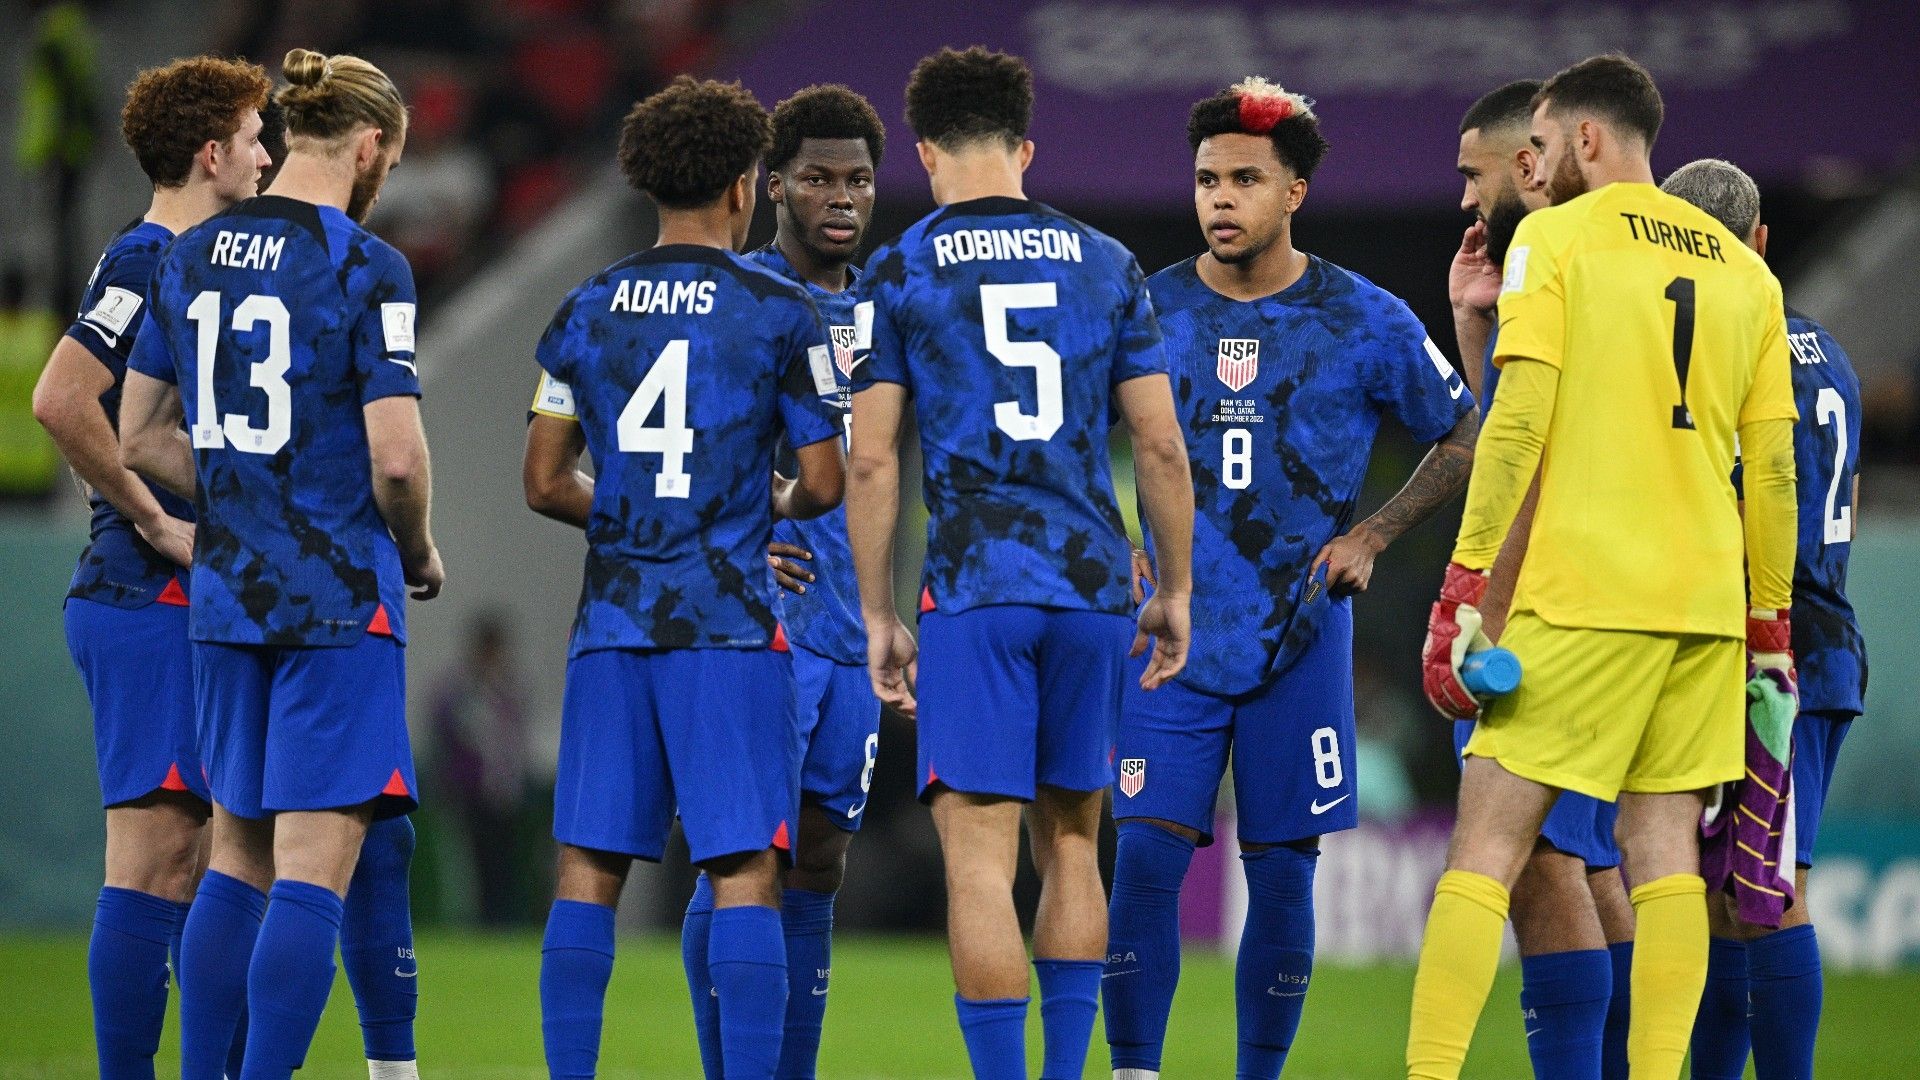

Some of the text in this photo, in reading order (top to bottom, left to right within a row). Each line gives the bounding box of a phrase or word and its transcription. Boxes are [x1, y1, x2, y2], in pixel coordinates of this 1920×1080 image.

[211, 231, 286, 271] REAM
[934, 229, 1083, 266] ROBINSON
[1620, 212, 1726, 263] TURNER
[610, 280, 717, 315] ADAMS
[832, 328, 857, 349] USA
[1221, 341, 1257, 361] USA
[1664, 276, 1697, 431] 1
[1787, 332, 1828, 365] DEST
[186, 290, 291, 454] 13
[979, 282, 1064, 442] 5
[616, 339, 694, 499] 4
[1211, 414, 1264, 423] 29 NOVEMBER 2022
[1220, 399, 1234, 407] IRAN
[1244, 399, 1256, 407] USA
[1220, 407, 1256, 415] DOHA, QATAR
[1222, 428, 1252, 490] 8
[1815, 387, 1852, 545] 2
[1122, 760, 1144, 776] USA
[1310, 726, 1343, 789] 8
[1278, 972, 1308, 985] USA
